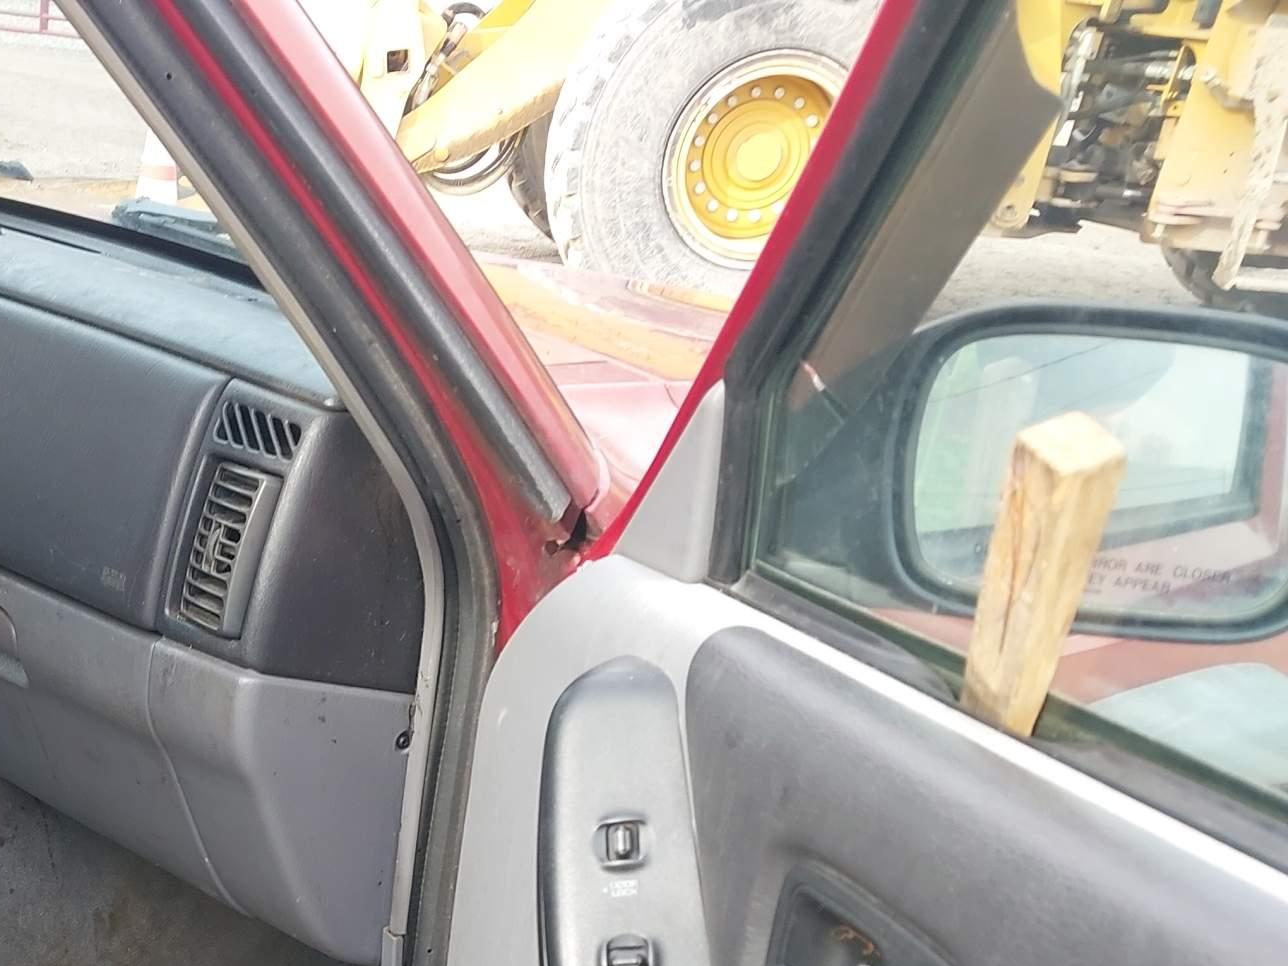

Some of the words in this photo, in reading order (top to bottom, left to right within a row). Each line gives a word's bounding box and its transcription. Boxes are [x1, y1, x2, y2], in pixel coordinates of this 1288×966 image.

[1134, 562, 1162, 575] ARE
[1172, 565, 1232, 583] CLOSER
[1113, 576, 1172, 594] APPEAR
